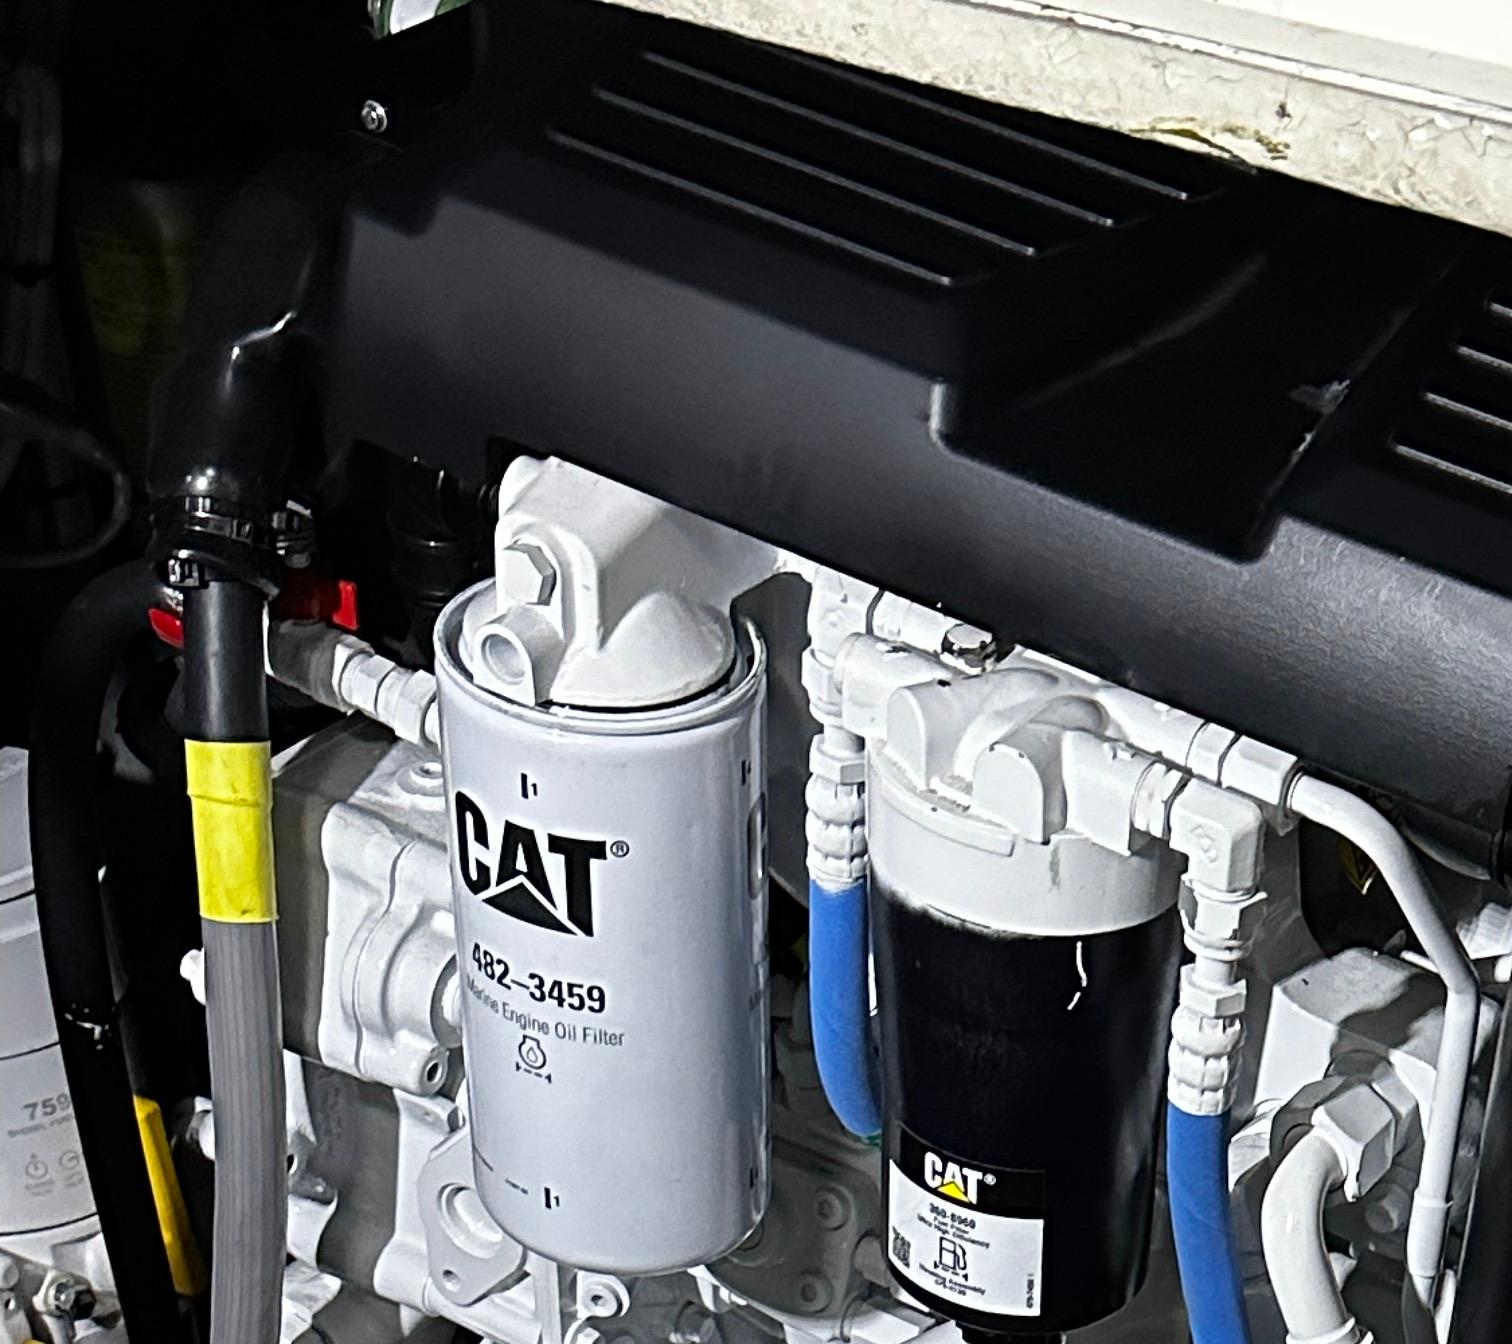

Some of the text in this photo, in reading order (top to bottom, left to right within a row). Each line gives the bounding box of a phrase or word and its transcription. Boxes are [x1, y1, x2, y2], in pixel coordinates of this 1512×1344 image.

[472, 942, 607, 1014] 482-3459
[502, 1002, 550, 1037] Engine
[554, 1020, 577, 1043] Oil
[582, 1026, 626, 1047] Filter
